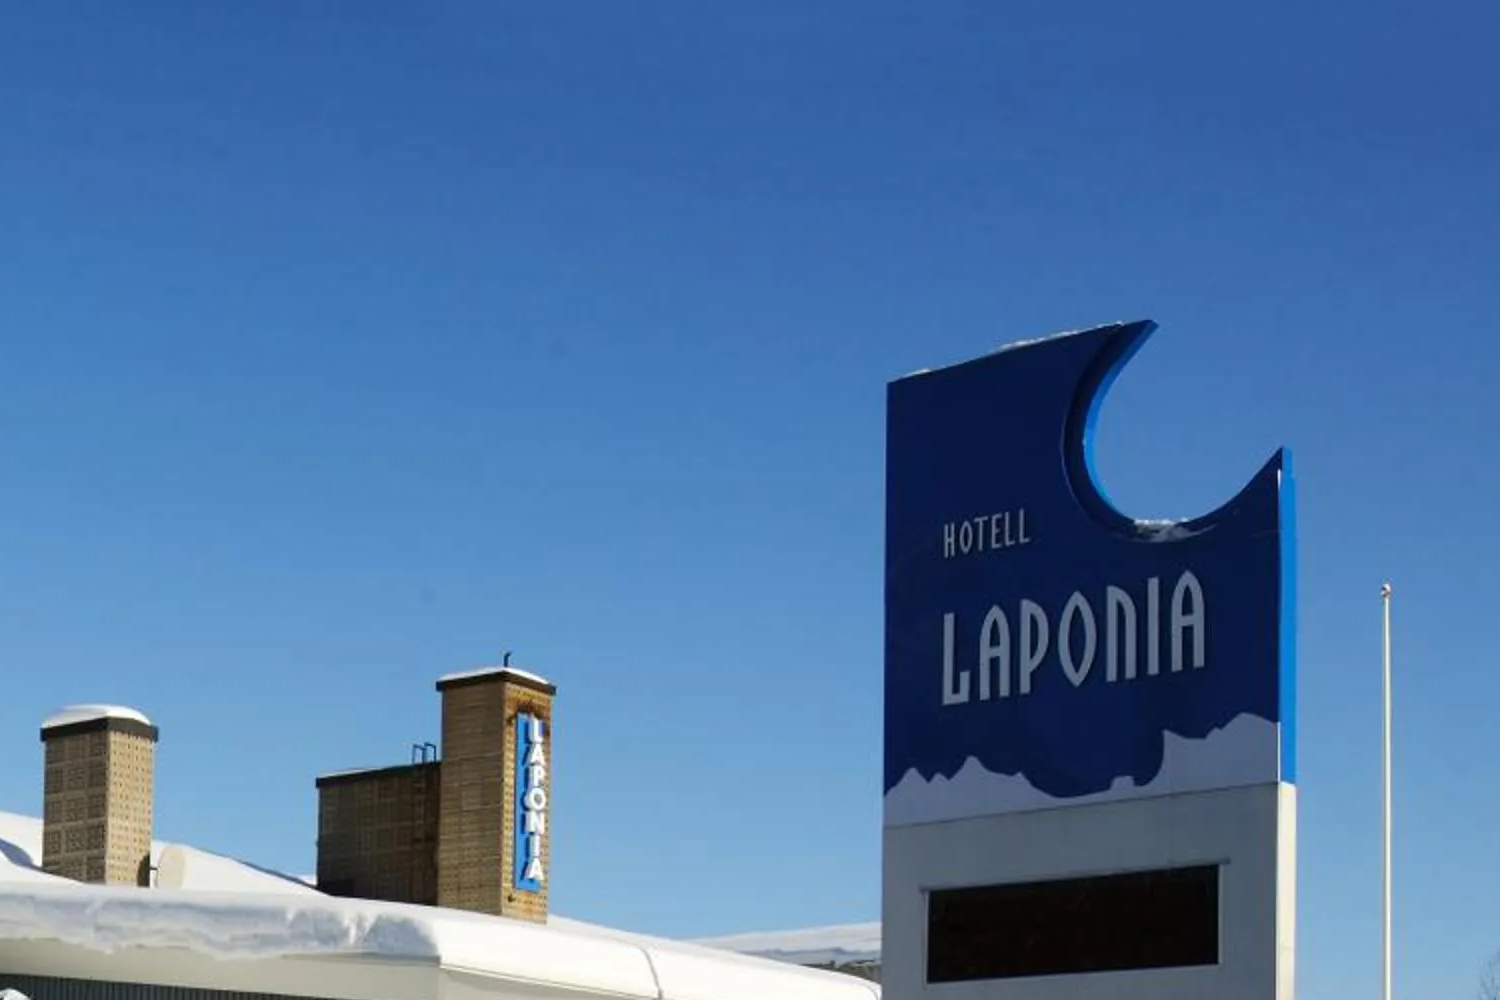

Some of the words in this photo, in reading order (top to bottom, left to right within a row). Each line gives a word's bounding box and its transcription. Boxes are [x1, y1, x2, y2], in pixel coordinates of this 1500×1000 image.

[943, 508, 1030, 558] HOTELL
[942, 569, 1205, 706] LAPONIA
[524, 713, 547, 880] LAPONIA
